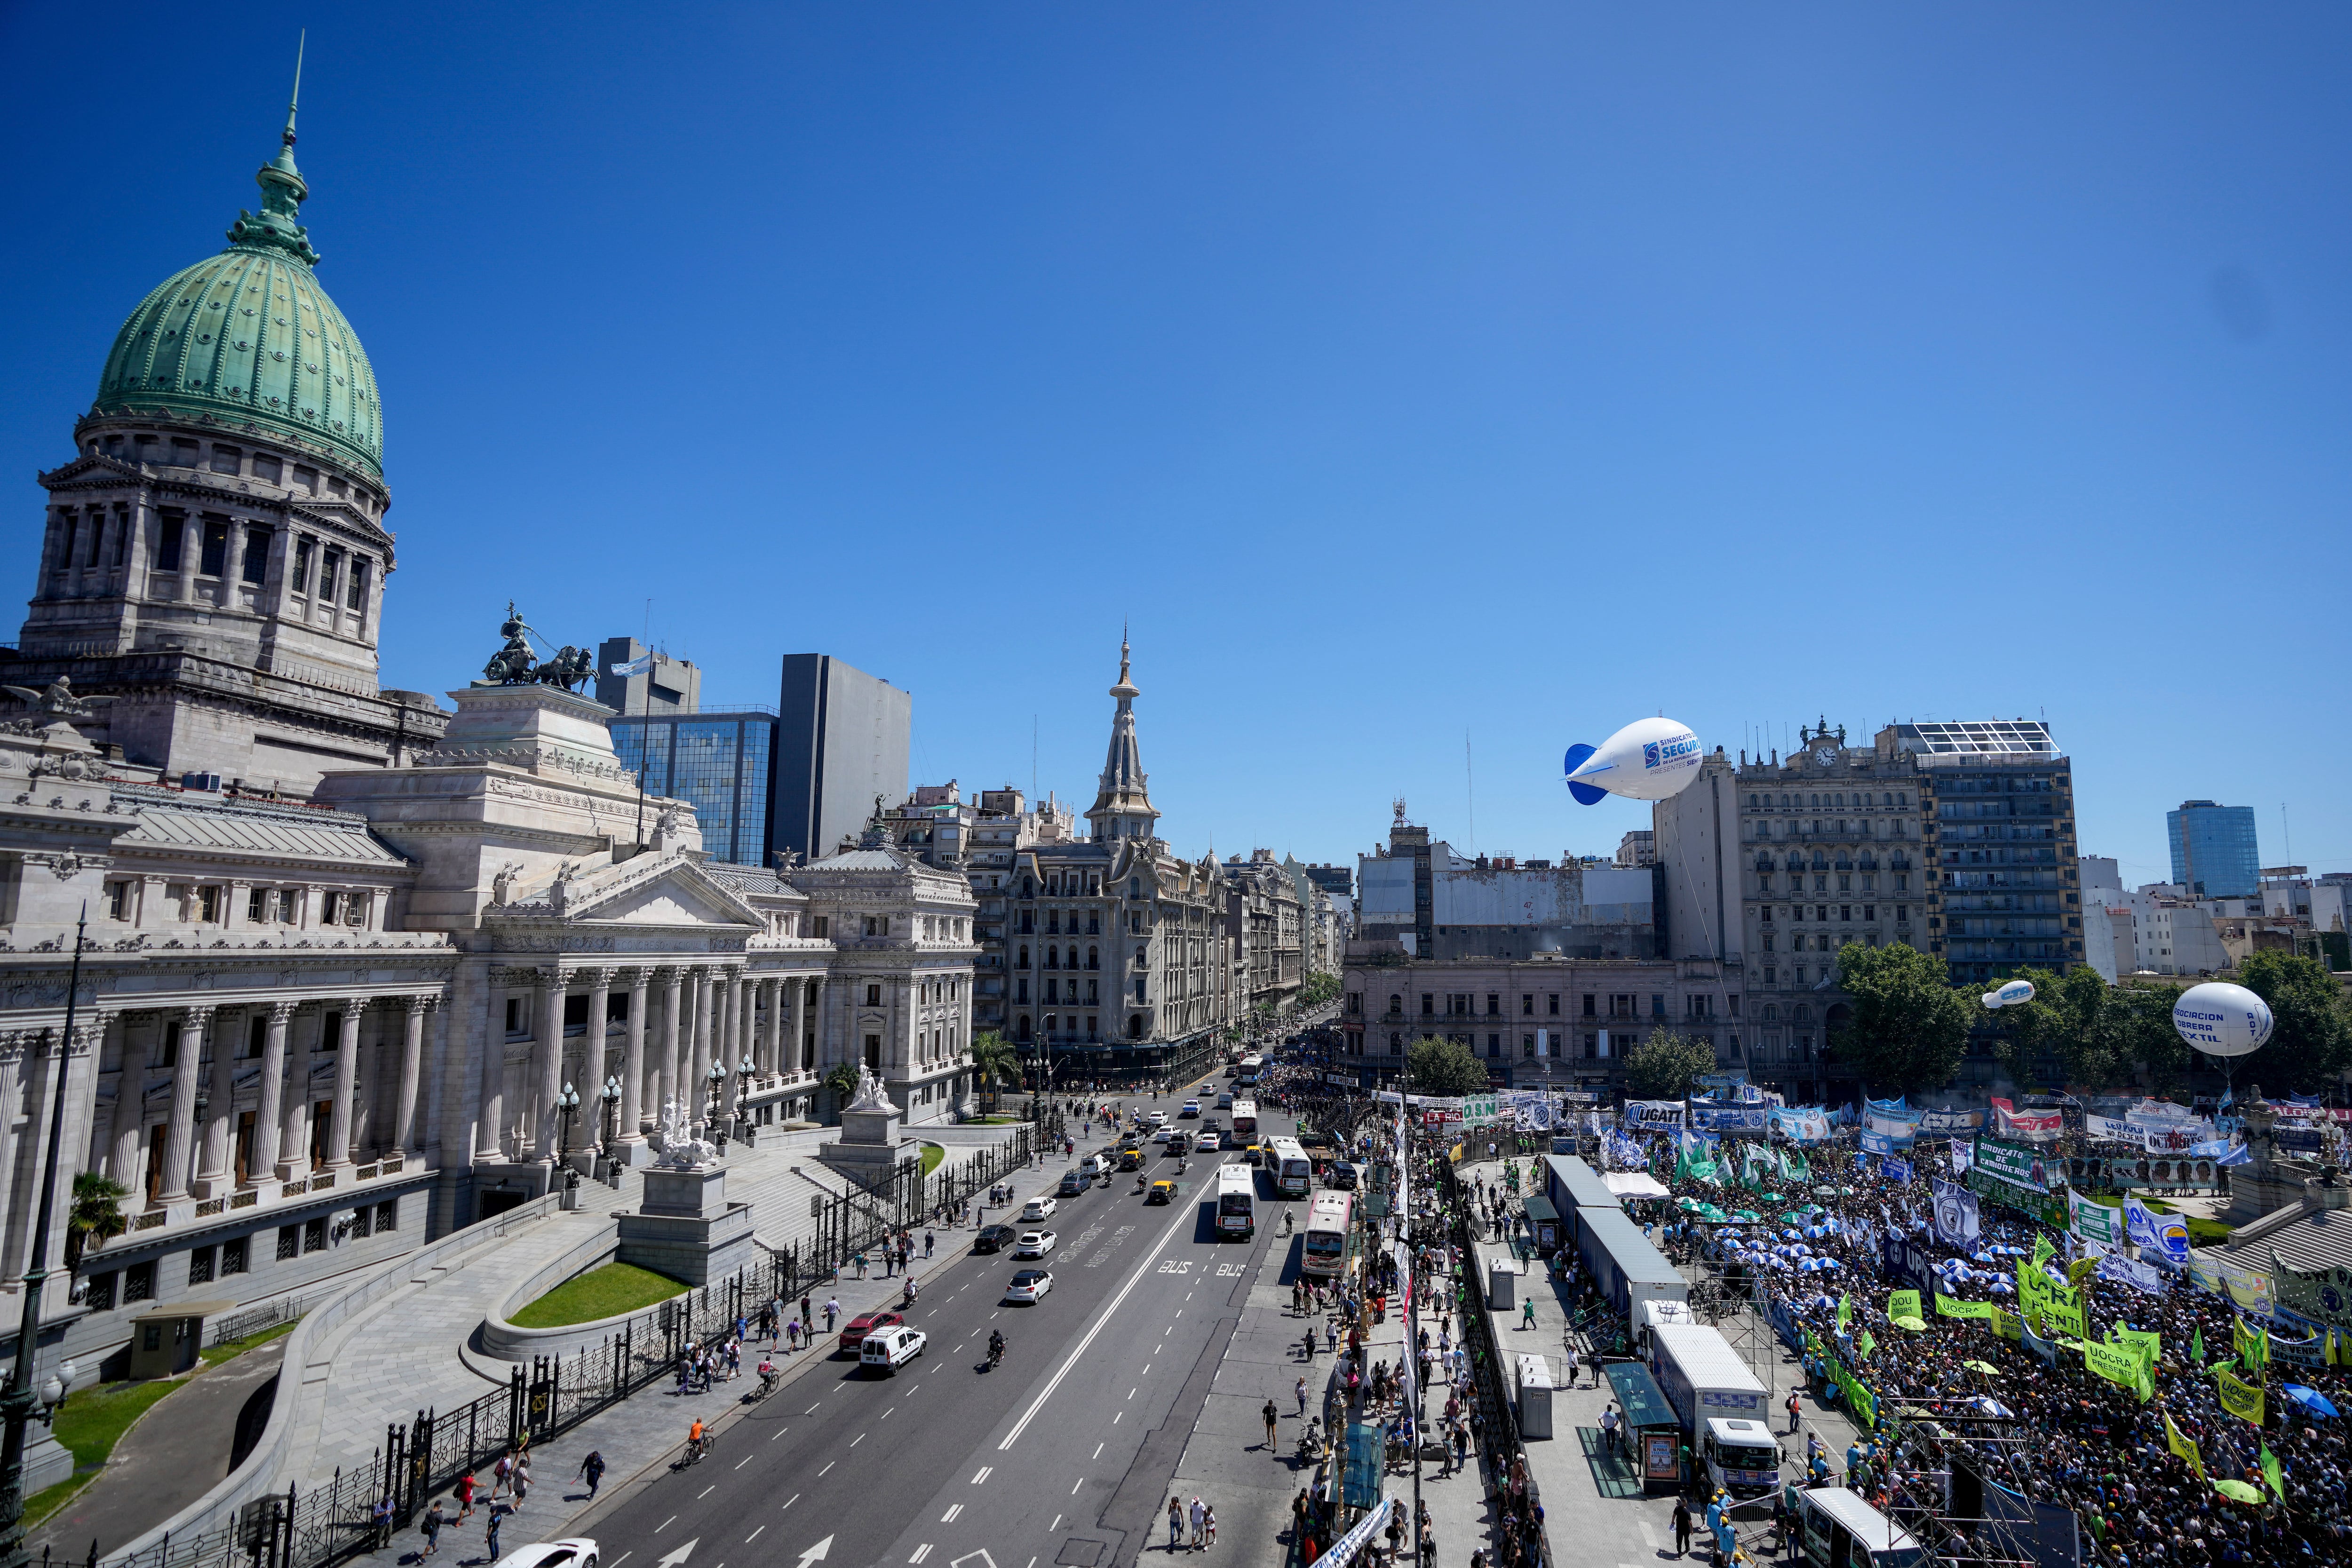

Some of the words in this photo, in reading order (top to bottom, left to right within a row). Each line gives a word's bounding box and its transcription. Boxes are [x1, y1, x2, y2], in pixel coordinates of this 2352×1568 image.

[1660, 733, 1692, 745] SINDICATO
[1650, 761, 1685, 776] PRESENTES
[622, 941, 665, 950] CONGRESO
[2001, 986, 2031, 1000] CTA
[2174, 1008, 2224, 1021] ASOCIACION
[2177, 1020, 2212, 1031] OBRERA
[2178, 1029, 2222, 1042] TEXTIL
[1427, 1113, 1439, 1122] LA
[1923, 1114, 1970, 1127] CTA
[2011, 1116, 2061, 1131] CTA
[1980, 1143, 2023, 1159] SINDICATO
[1995, 1155, 2008, 1164] DE
[1888, 1164, 1903, 1173] MATANZA
[1980, 1158, 2030, 1178] CAMIONEROS
[2082, 1216, 2106, 1229] ALIMENTACIÓN
[1157, 1260, 1193, 1274] BUS
[1216, 1263, 1247, 1277] BUS
[1907, 1246, 1929, 1292] UPCN
[1943, 1303, 1979, 1313] UOCRA
[2280, 1297, 2302, 1312] POR
[2305, 1307, 2323, 1319] LA
[2279, 1312, 2294, 1323] PATRIA
[2271, 1350, 2312, 1364] UOCRA
[2289, 1346, 2321, 1354] VENDE
[2090, 1346, 2131, 1369] UOCRA
[2092, 1359, 2132, 1378] PRESENTE
[2222, 1380, 2255, 1403] UOCRA
[2221, 1393, 2254, 1412] PRESENTE
[1330, 1541, 1348, 1562] NO
[1348, 1531, 1357, 1544] SE
